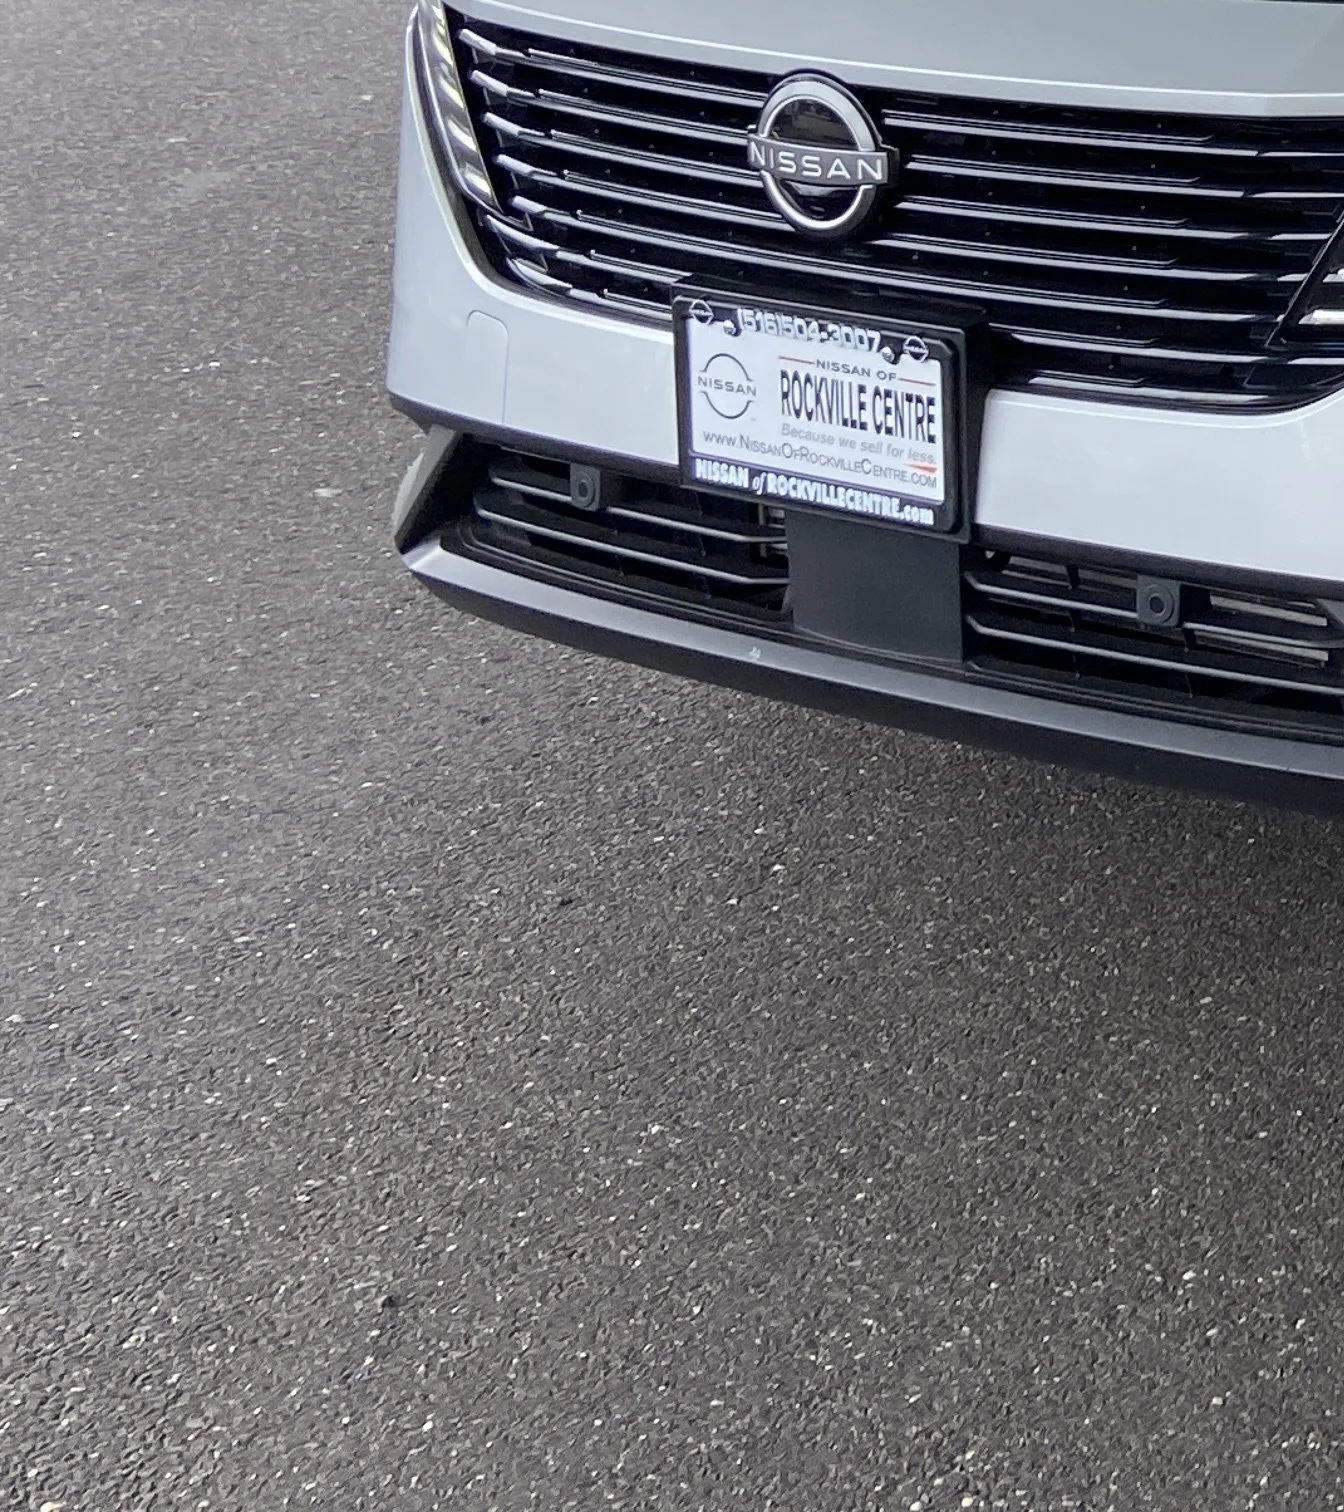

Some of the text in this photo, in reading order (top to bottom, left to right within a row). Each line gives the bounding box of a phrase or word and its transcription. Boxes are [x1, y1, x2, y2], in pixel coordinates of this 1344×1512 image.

[750, 141, 882, 180] NISSAN
[697, 375, 757, 397] NISSAN
[816, 359, 897, 381] NISSAN OF
[780, 369, 936, 444] ROCKVILLE CENTRE
[781, 423, 835, 445] Because
[839, 437, 857, 449] we
[861, 441, 883, 454] sell
[886, 443, 904, 458] for
[696, 458, 749, 488] NISSAN
[752, 471, 767, 496] of
